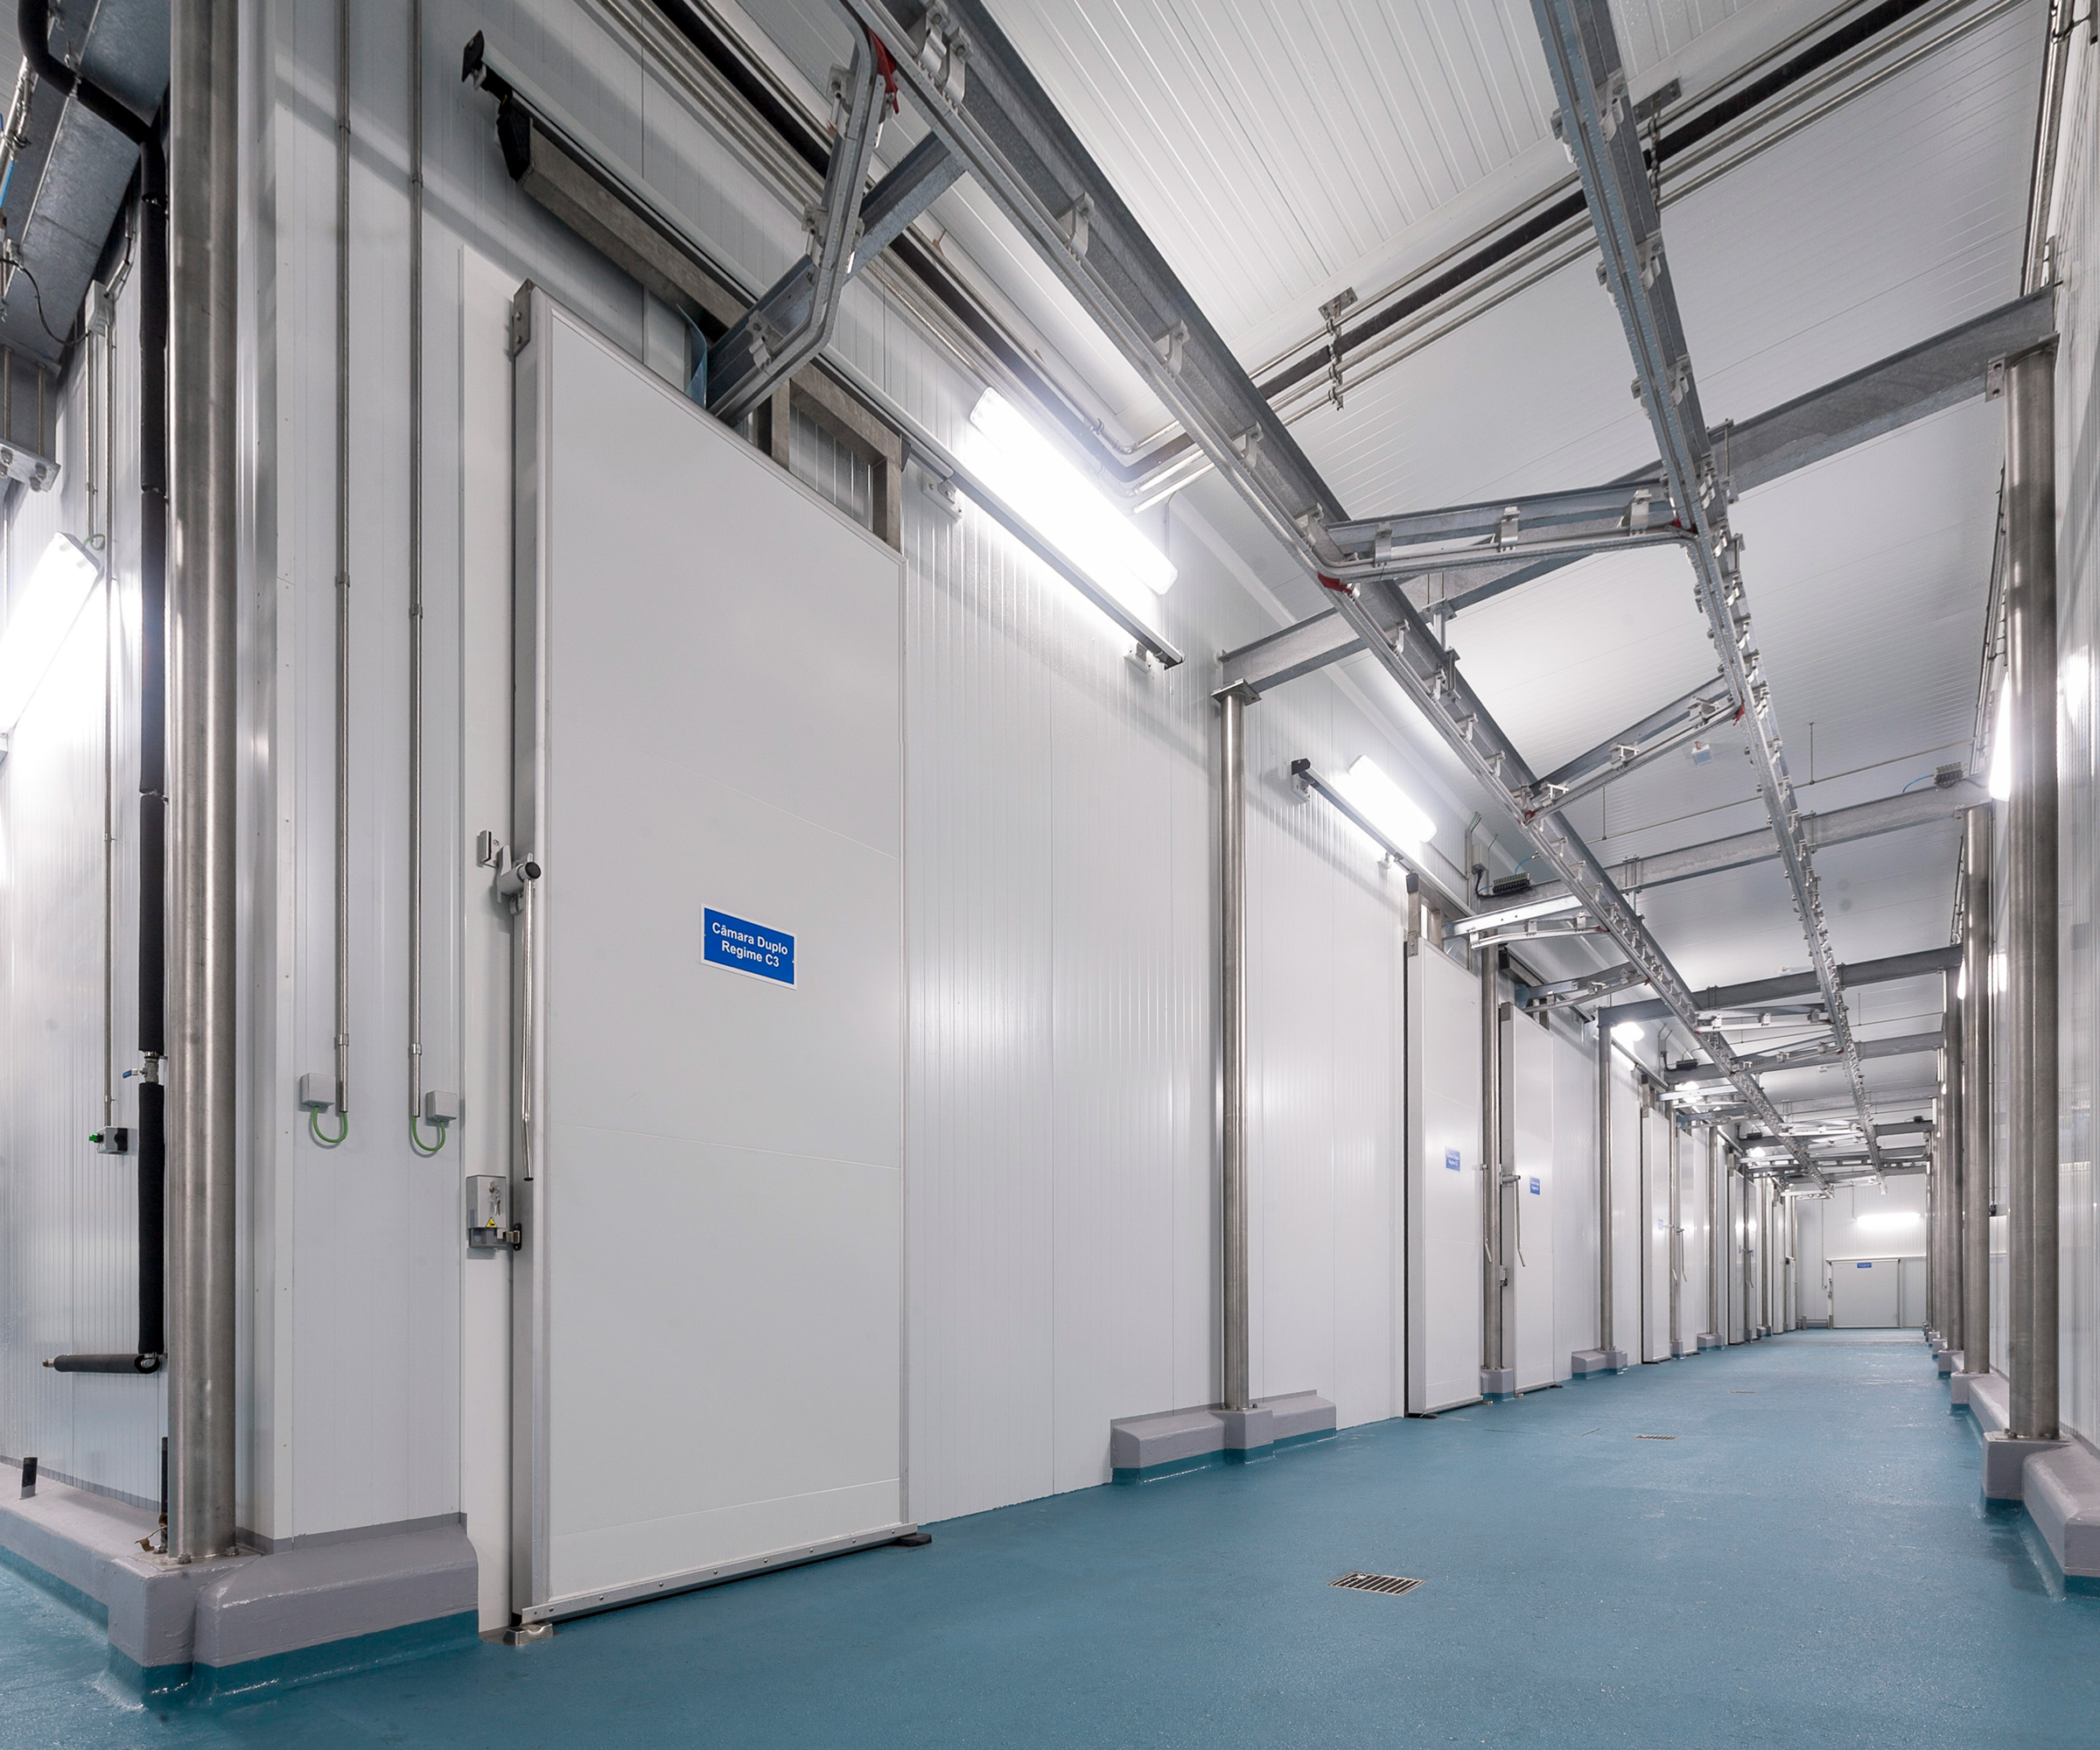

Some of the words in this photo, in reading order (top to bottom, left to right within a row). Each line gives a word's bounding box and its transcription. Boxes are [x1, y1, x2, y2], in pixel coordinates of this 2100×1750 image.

[711, 921, 754, 945] Câmara
[757, 935, 788, 956] Duplo
[721, 940, 763, 962] Regime
[765, 953, 780, 968] C3
